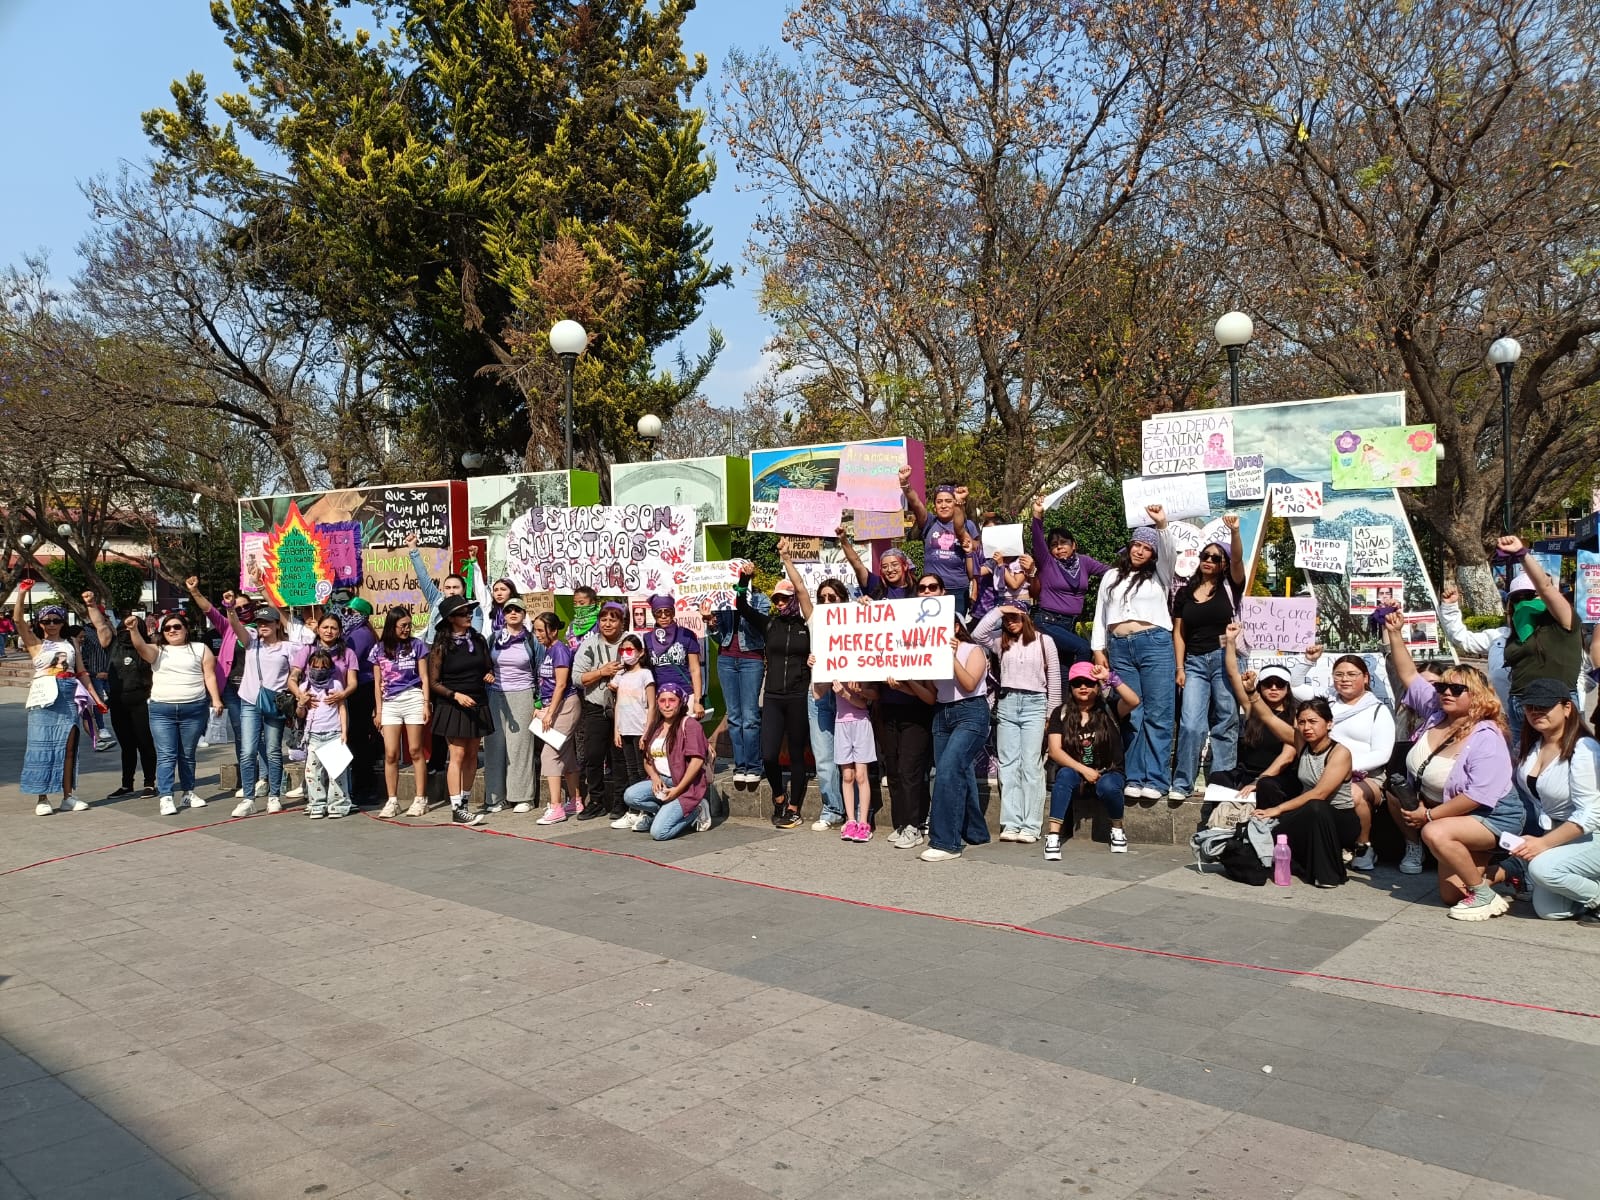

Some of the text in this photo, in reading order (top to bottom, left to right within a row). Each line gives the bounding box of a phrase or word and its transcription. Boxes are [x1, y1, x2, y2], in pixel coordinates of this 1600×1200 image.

[1147, 416, 1229, 434] SE LO DEBO A
[1144, 436, 1170, 450] ESA
[1143, 444, 1204, 461] QUE NO PUDO
[1149, 458, 1198, 474] GRITAR
[1275, 486, 1292, 496] NO
[416, 502, 429, 516] NO
[432, 504, 447, 514] nos
[1288, 504, 1305, 514] NO
[420, 517, 430, 527] ni
[431, 514, 440, 527] la
[531, 504, 672, 532] ESTAS SON
[1354, 528, 1370, 540] LAS
[519, 531, 648, 562] NUESTRAS
[1354, 536, 1391, 550] NIÑAS
[366, 552, 431, 572] HONRAMS
[790, 550, 820, 560] HINGONA
[1356, 553, 1388, 568] TOCAN
[1305, 560, 1342, 570] FUERZA
[538, 562, 641, 591] FORMAS
[376, 603, 394, 615] LAS
[826, 604, 896, 626] MI HIJA
[1270, 601, 1285, 619] te
[1243, 619, 1285, 634] nque el
[829, 632, 893, 652] MERECE
[902, 626, 949, 650] VIVIR
[1278, 634, 1290, 644] no
[1296, 633, 1308, 644] te
[826, 654, 933, 671] NO SOBREVIVIR
[1246, 656, 1301, 670] FEMINIS
